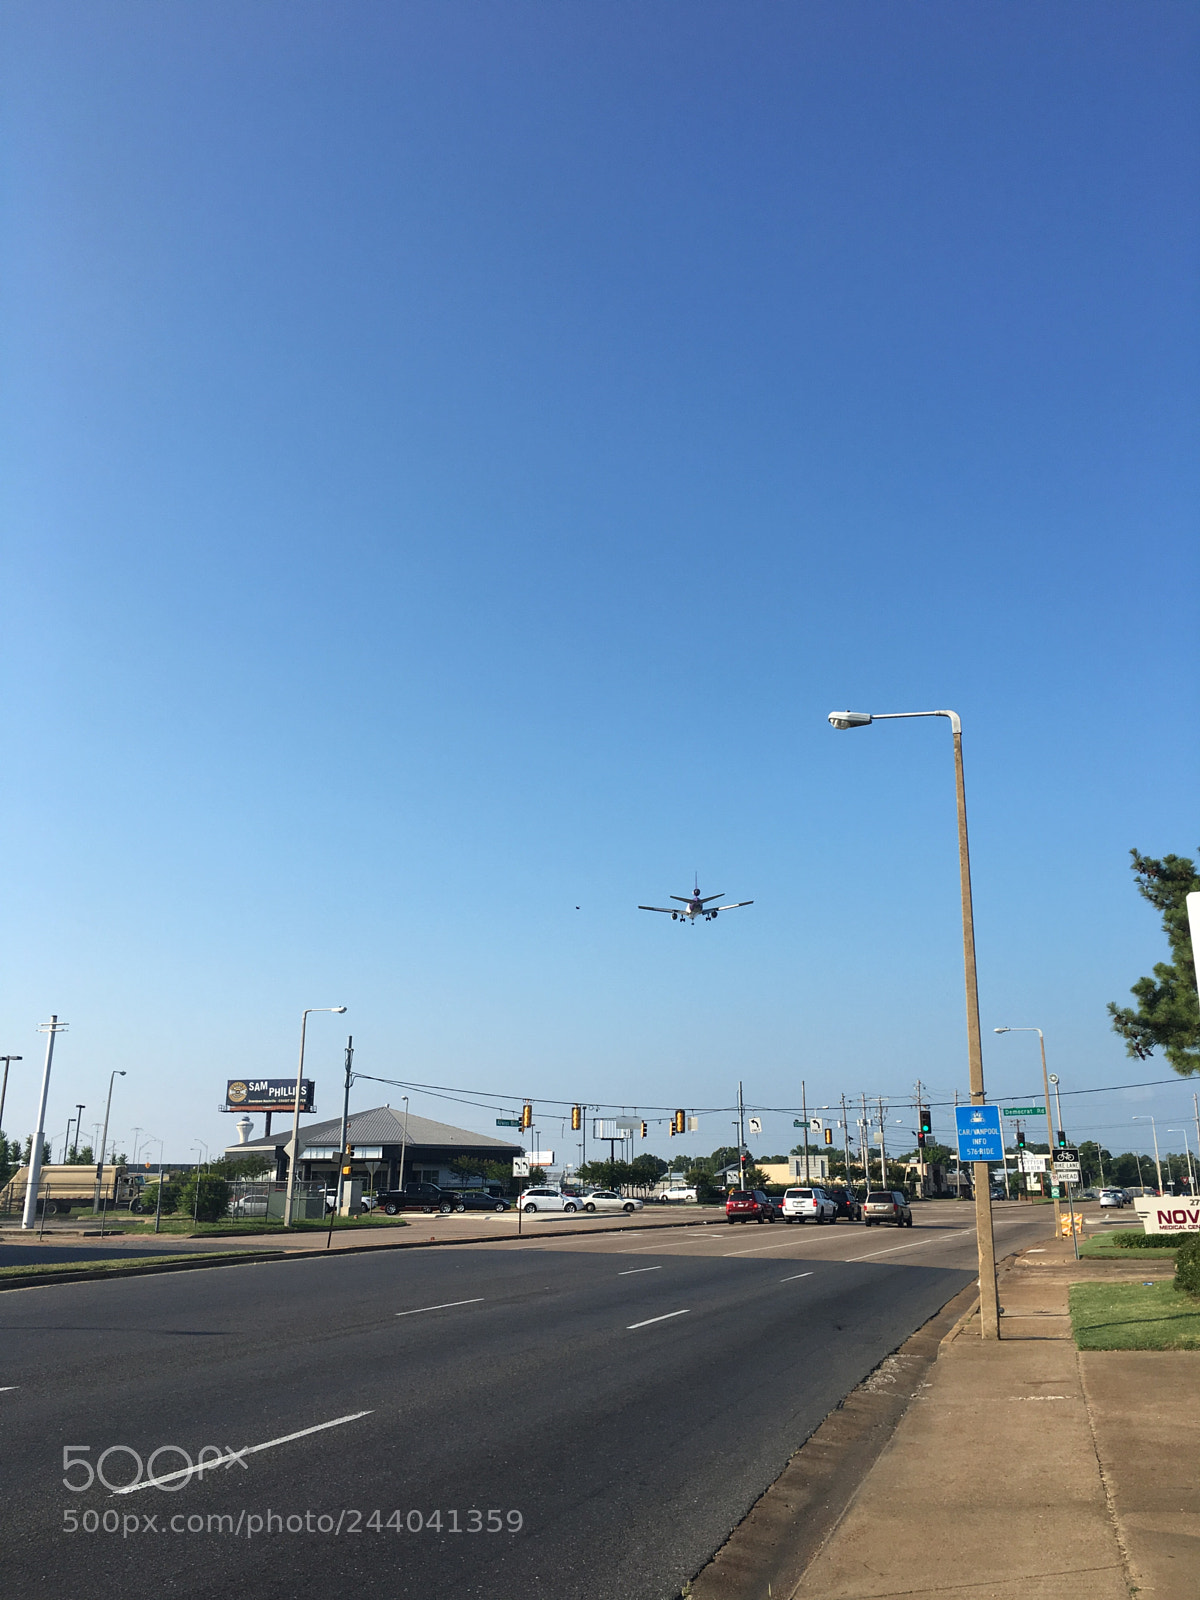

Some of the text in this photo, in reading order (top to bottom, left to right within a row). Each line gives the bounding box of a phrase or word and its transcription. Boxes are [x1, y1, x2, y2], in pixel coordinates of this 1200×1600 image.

[249, 1081, 268, 1092] SAM
[268, 1086, 307, 1097] PHILLIS
[958, 1128, 1000, 1136] CAR/VANPOOL
[966, 1147, 995, 1155] 576-RIDE
[1157, 1210, 1200, 1224] NOV
